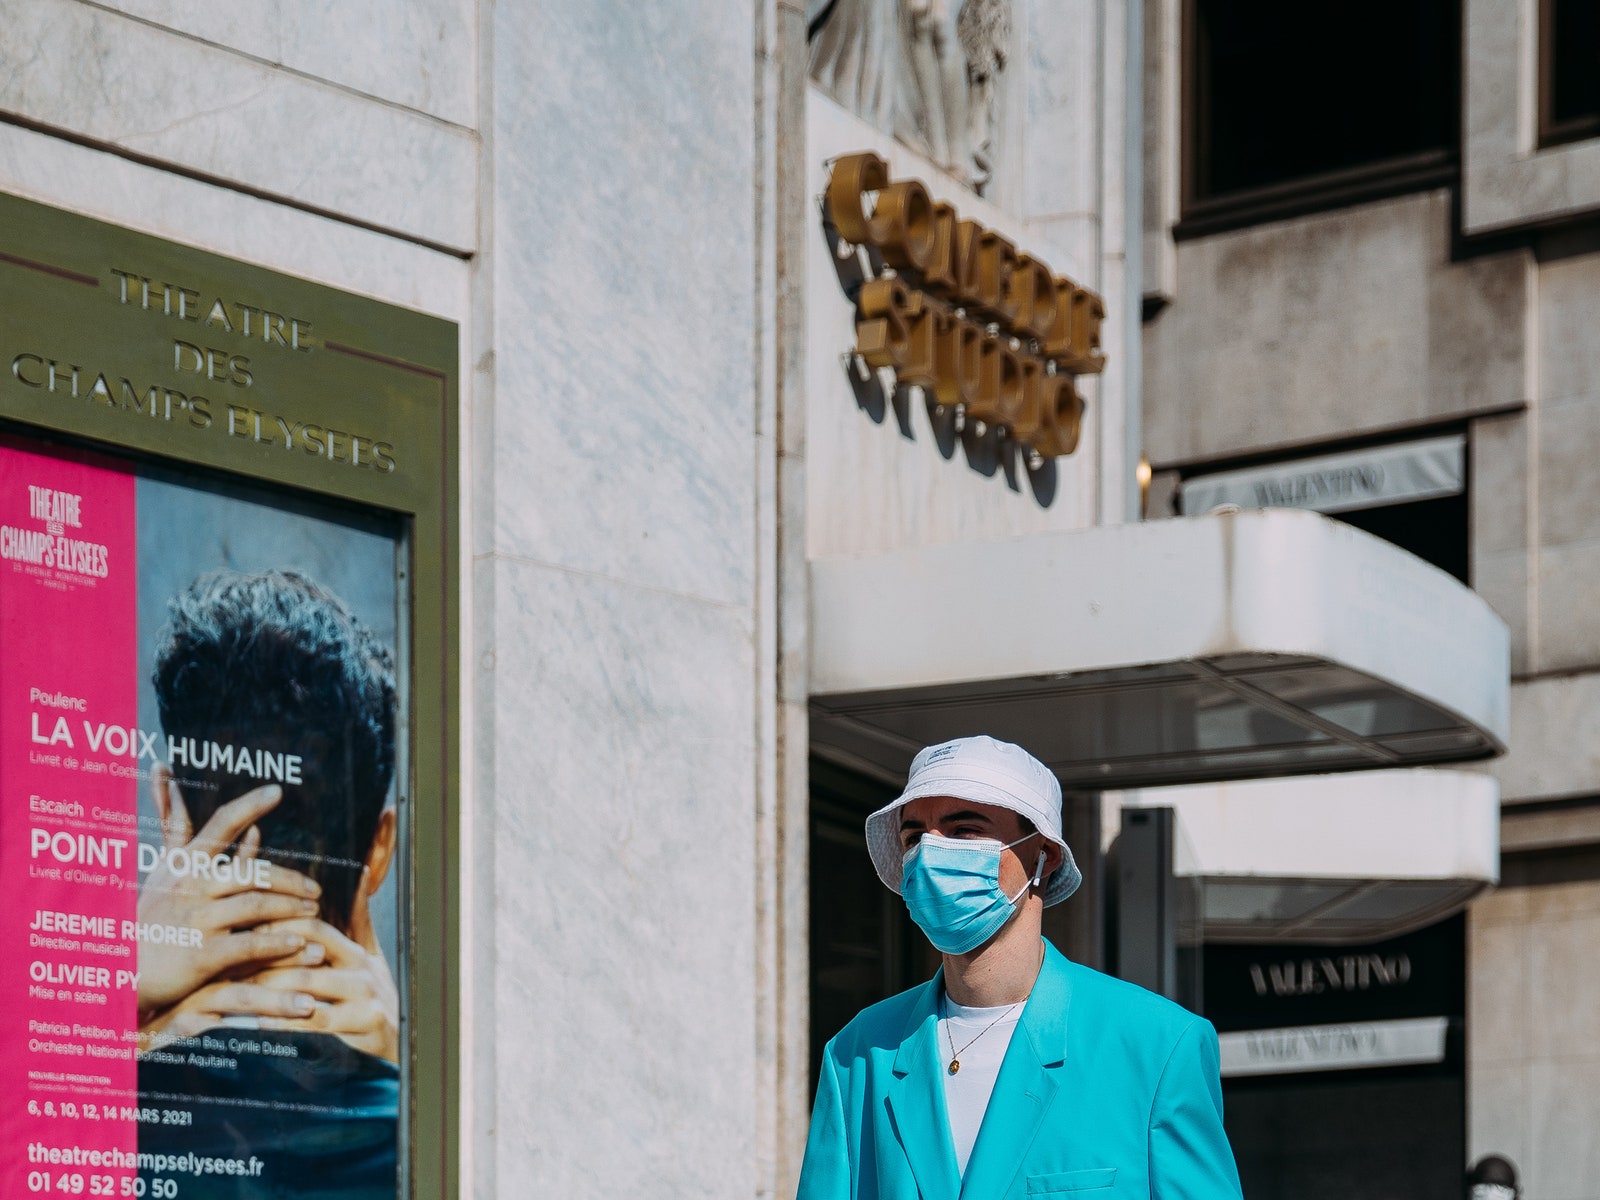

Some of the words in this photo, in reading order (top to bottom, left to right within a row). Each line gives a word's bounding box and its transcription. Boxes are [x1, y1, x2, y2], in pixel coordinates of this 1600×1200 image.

[110, 268, 313, 353] THEATRE
[174, 338, 253, 388] DES
[12, 352, 213, 429] CHAMPS
[227, 403, 396, 473] ELYSEES
[28, 485, 82, 528] THEATRE
[30, 687, 87, 712] Poulenc
[30, 750, 61, 769] Livret
[63, 756, 79, 770] de
[80, 759, 107, 775] Jean
[32, 712, 74, 749] LA
[83, 720, 158, 760] VOIX
[168, 734, 303, 785] HUMAINE
[29, 794, 84, 818] Escaich
[31, 828, 128, 870] POINT
[138, 842, 272, 889] D'ORGUE
[29, 864, 61, 880] Livret
[64, 869, 106, 886] d'Olivier
[110, 874, 124, 890] Py
[29, 909, 116, 939] JEREMIE
[121, 920, 203, 949] RHORER
[29, 933, 81, 951] Direction
[82, 941, 131, 957] musicale
[29, 961, 111, 989] OLIVIER
[116, 969, 142, 991] PY
[1249, 953, 1412, 997] VALENTINO
[29, 985, 56, 1000] Mise
[57, 990, 72, 1001] en
[29, 1019, 71, 1036] Patricia
[29, 1038, 84, 1057] Orchestre
[86, 1043, 131, 1060] National
[134, 1048, 186, 1065] Bordeaux
[188, 1052, 238, 1070] Aquitaine
[27, 1100, 41, 1117] 6,
[44, 1101, 57, 1119] 8,
[60, 1102, 79, 1120] 10,
[82, 1104, 100, 1122] 12,
[103, 1105, 117, 1121] 14
[121, 1107, 160, 1125] MARS
[162, 1110, 192, 1127] 2021
[28, 1142, 264, 1177] theatrechampselysees.fr
[27, 1171, 50, 1192] 01
[56, 1173, 84, 1194] 49
[89, 1175, 115, 1196] 52
[120, 1177, 146, 1198] 50
[151, 1178, 178, 1199] 50
